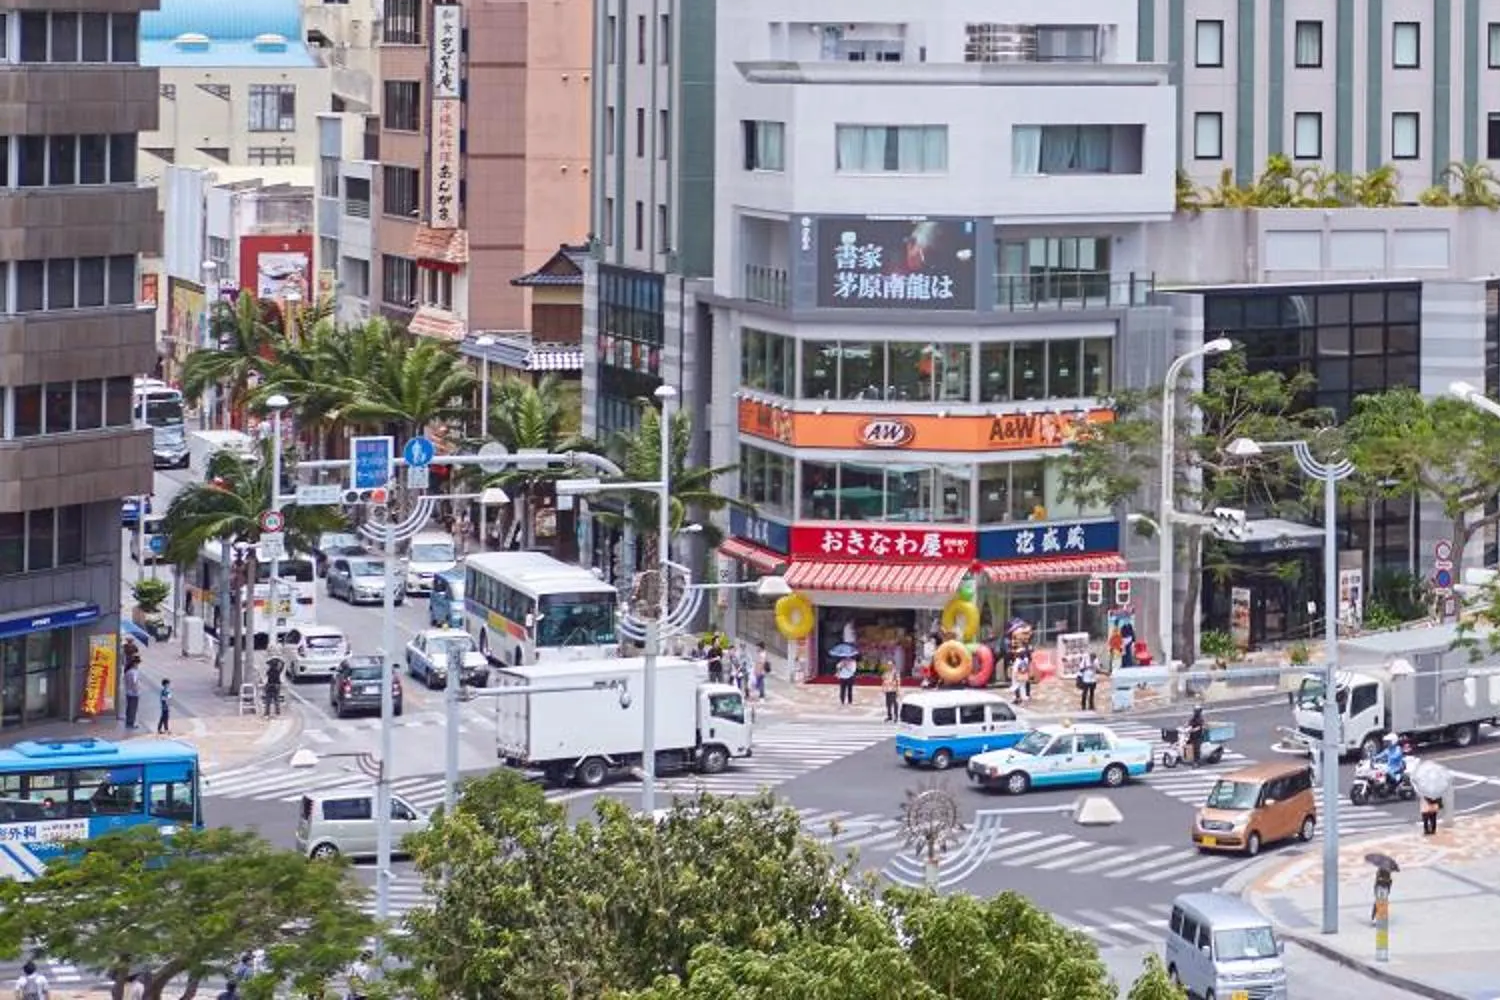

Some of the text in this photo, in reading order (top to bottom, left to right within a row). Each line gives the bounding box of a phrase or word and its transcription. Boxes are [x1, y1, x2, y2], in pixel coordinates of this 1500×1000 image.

[989, 415, 1037, 441] A&W
[821, 530, 943, 557] おきなわ屋
